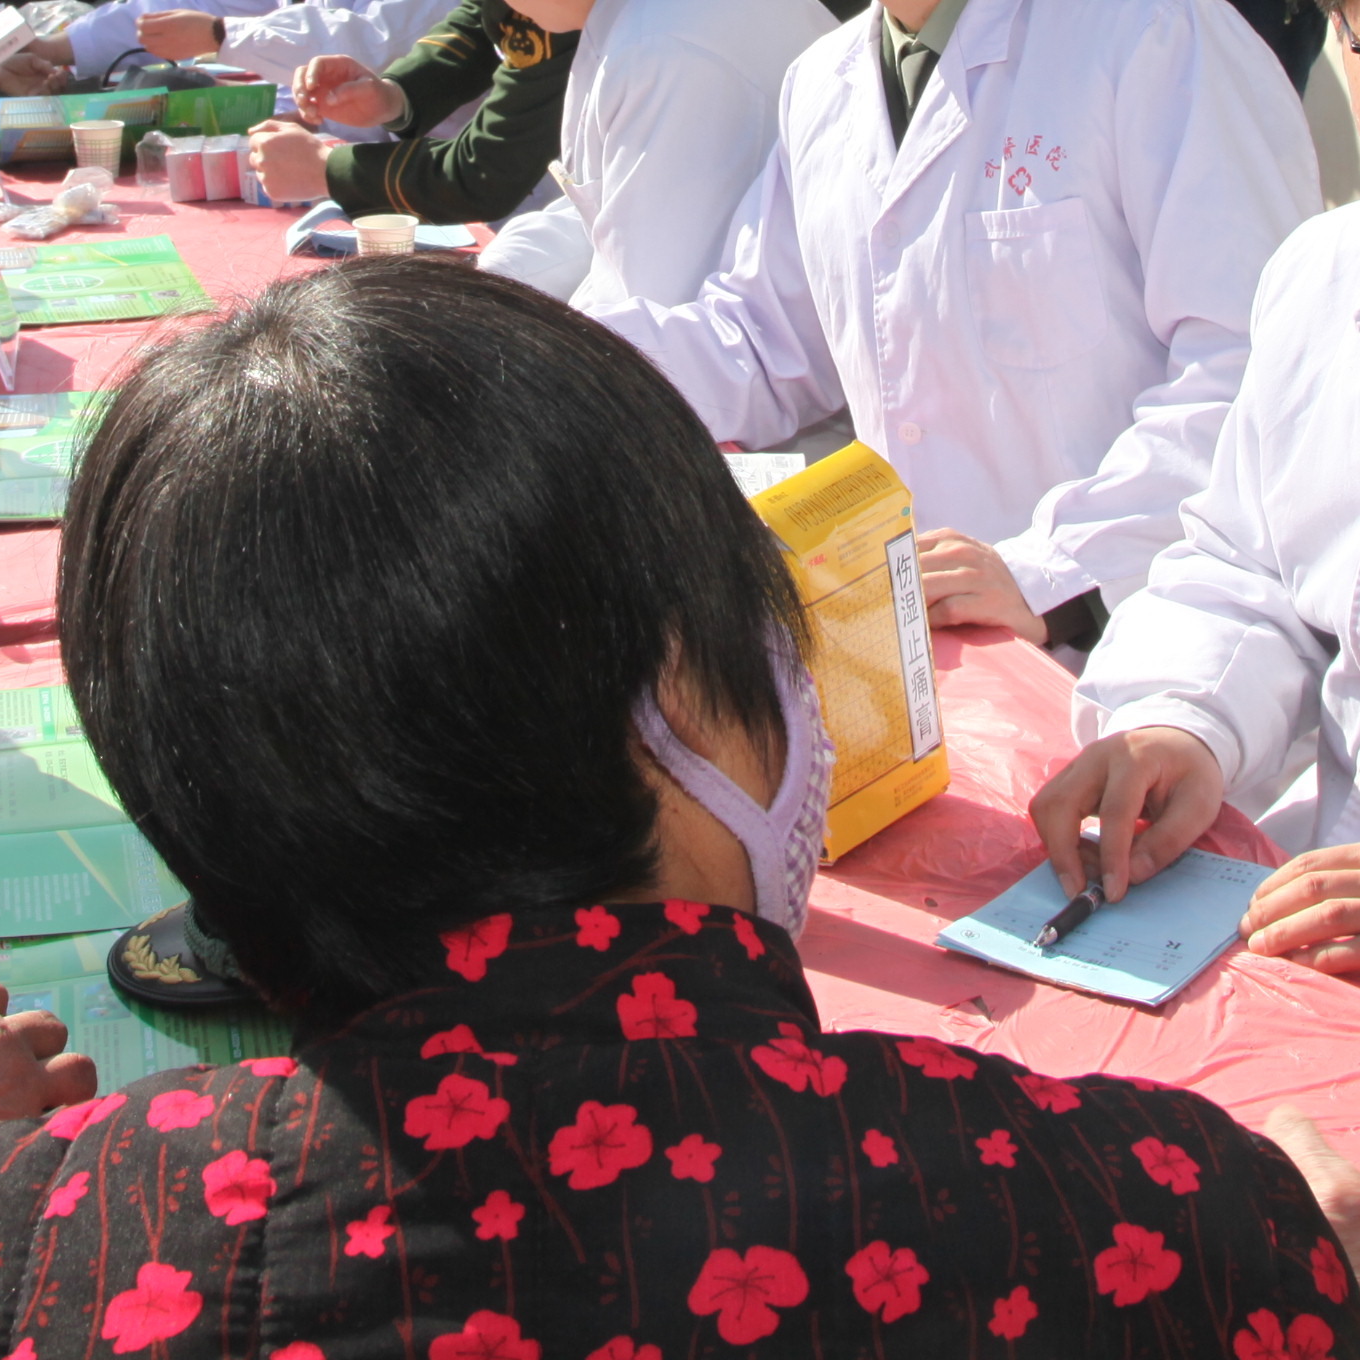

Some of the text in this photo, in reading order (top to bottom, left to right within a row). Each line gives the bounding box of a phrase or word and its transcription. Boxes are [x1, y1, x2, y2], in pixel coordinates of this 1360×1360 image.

[895, 553, 932, 741] 伤湿止痛膏
